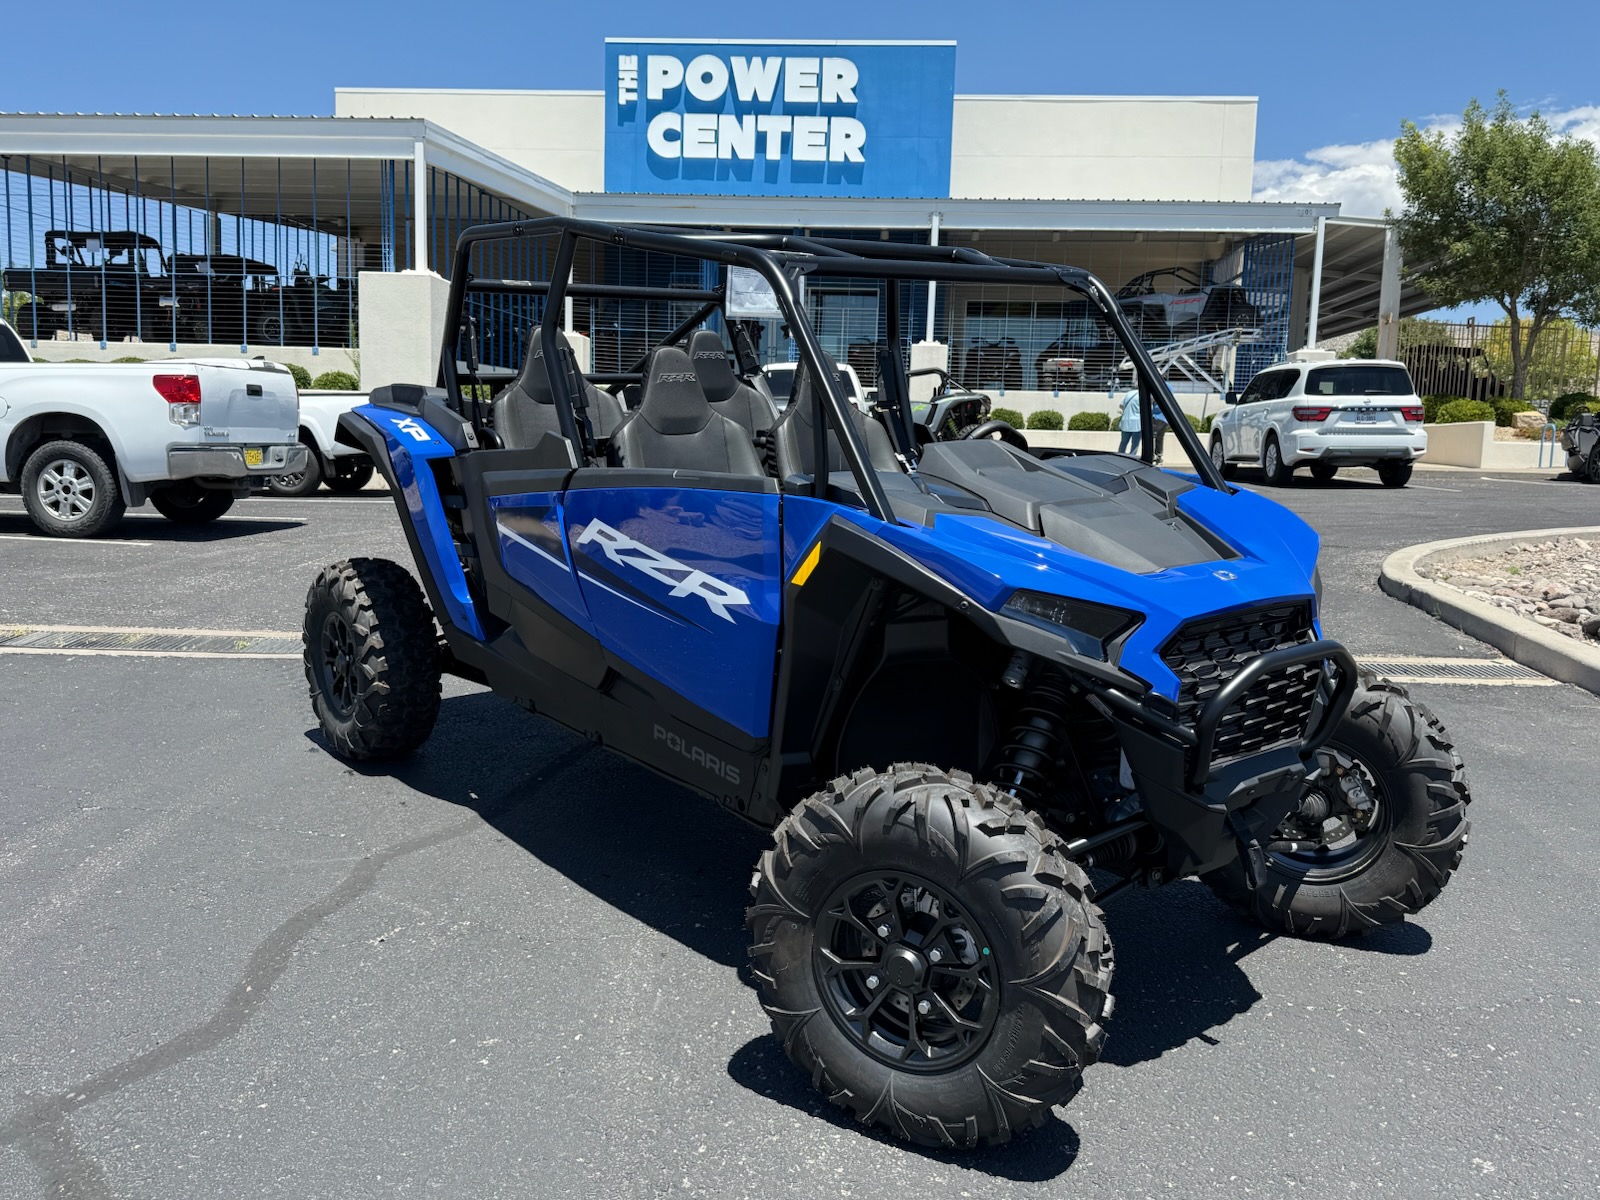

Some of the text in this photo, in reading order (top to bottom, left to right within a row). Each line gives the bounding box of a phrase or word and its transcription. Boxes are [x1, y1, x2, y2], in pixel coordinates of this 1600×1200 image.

[618, 54, 639, 105] THE
[647, 53, 859, 104] POWER
[647, 111, 867, 163] CENTER
[657, 372, 696, 384] RZR
[693, 350, 725, 360] RZR
[390, 417, 432, 442] XP
[575, 517, 751, 625] RZR
[653, 723, 741, 786] POLARIS
